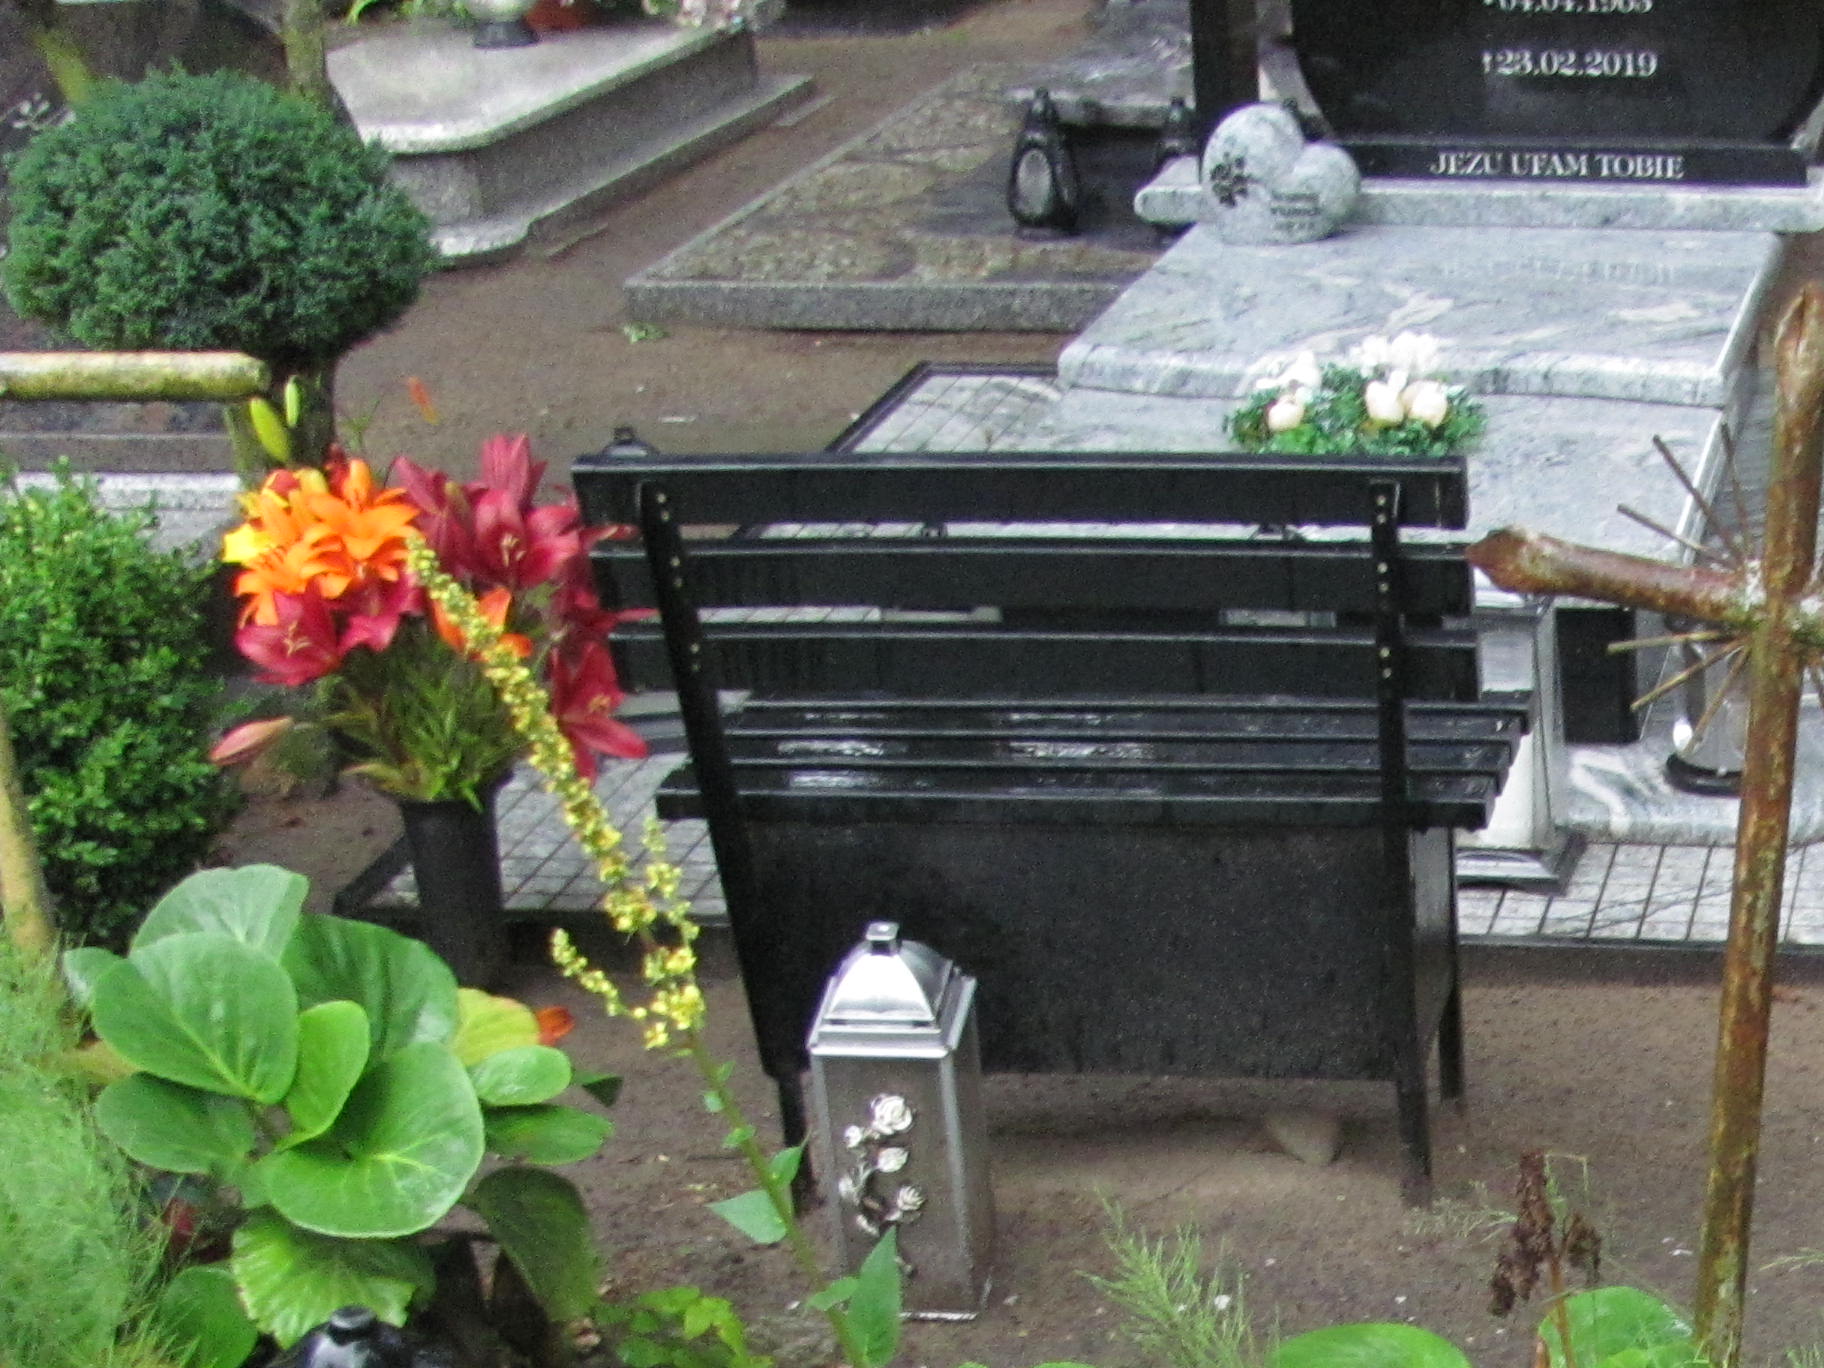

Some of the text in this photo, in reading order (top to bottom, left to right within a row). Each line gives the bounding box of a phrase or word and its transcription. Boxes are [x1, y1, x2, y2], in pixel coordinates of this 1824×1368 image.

[1429, 152, 1684, 179] JEZU UFAM TOBIE
